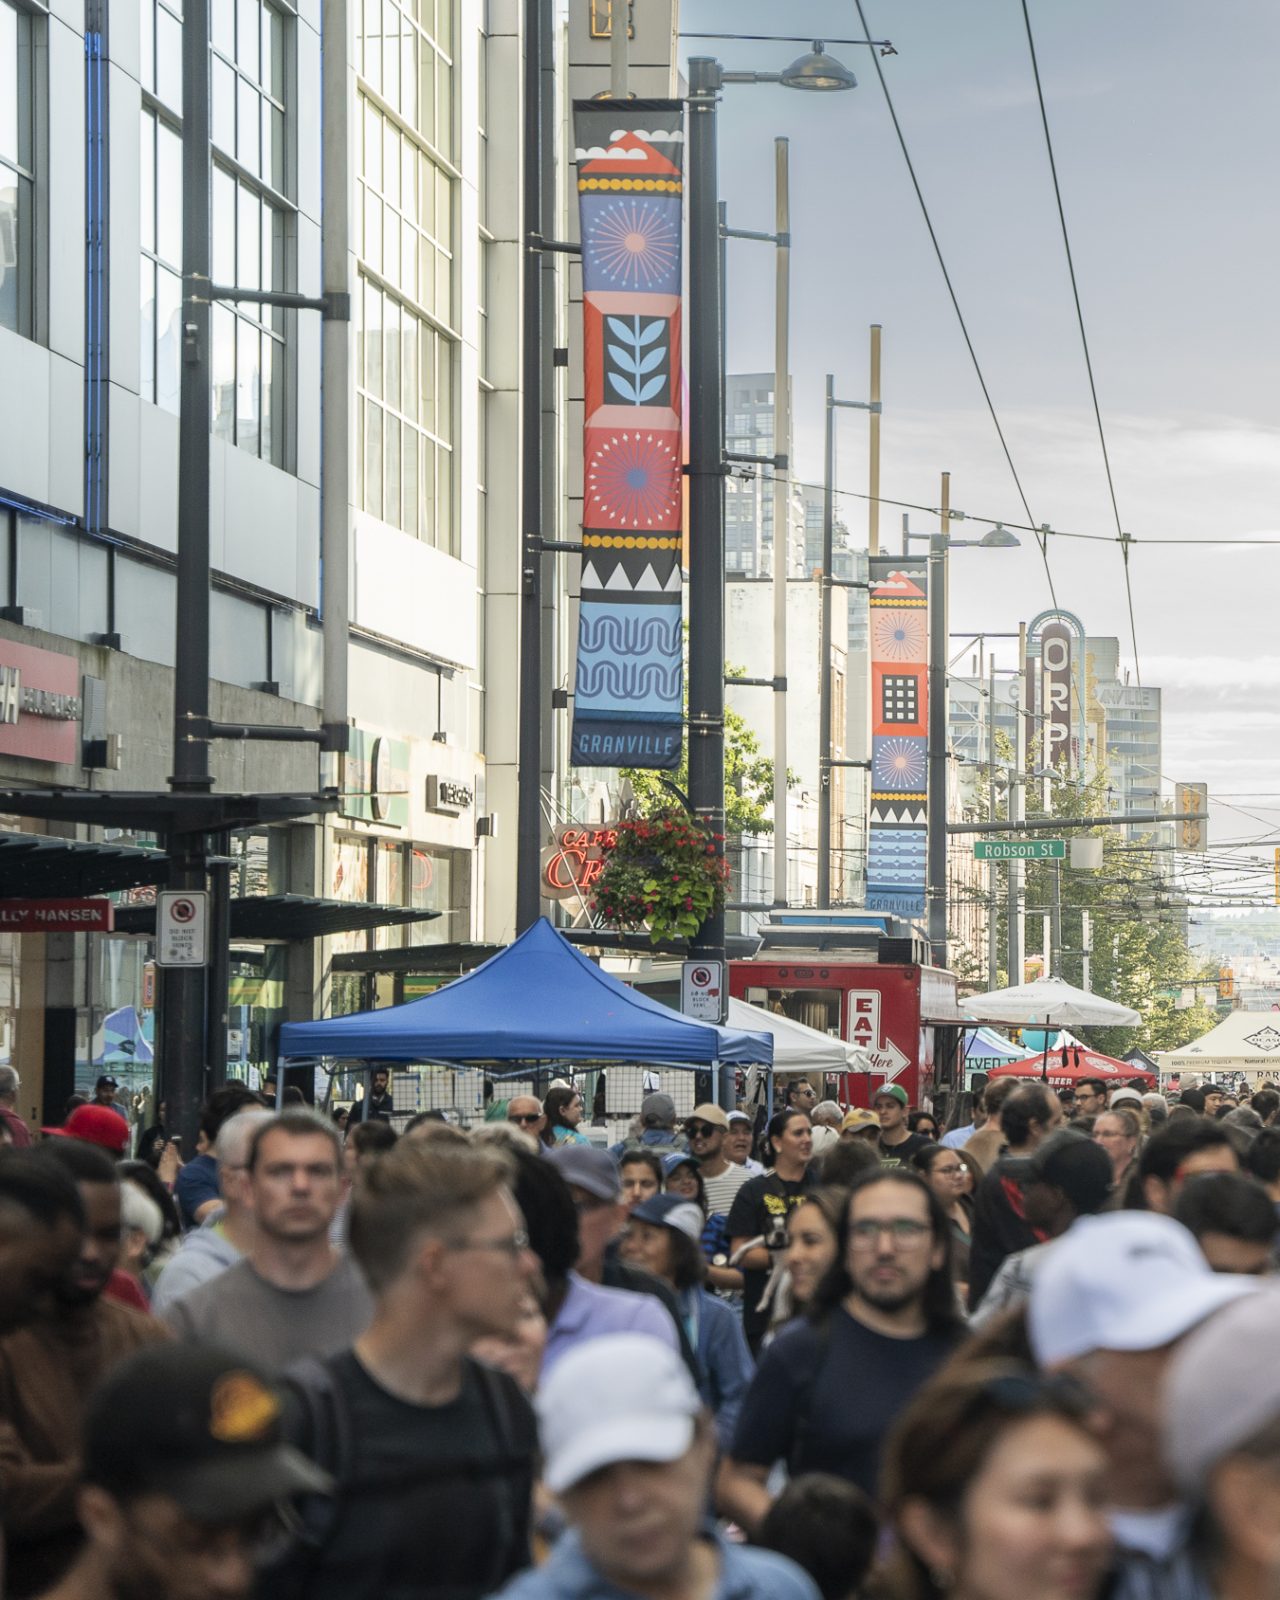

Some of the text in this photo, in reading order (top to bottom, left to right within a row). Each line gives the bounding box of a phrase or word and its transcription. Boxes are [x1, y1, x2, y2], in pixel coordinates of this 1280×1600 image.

[579, 734, 673, 755] GRANVILLE
[985, 843, 1054, 857] Robson St
[870, 898, 922, 912] GRANVILLE
[36, 908, 102, 921] HANSEN
[854, 998, 872, 1047] EAT
[868, 1053, 893, 1068] Here
[1048, 1077, 1073, 1085] BEER
